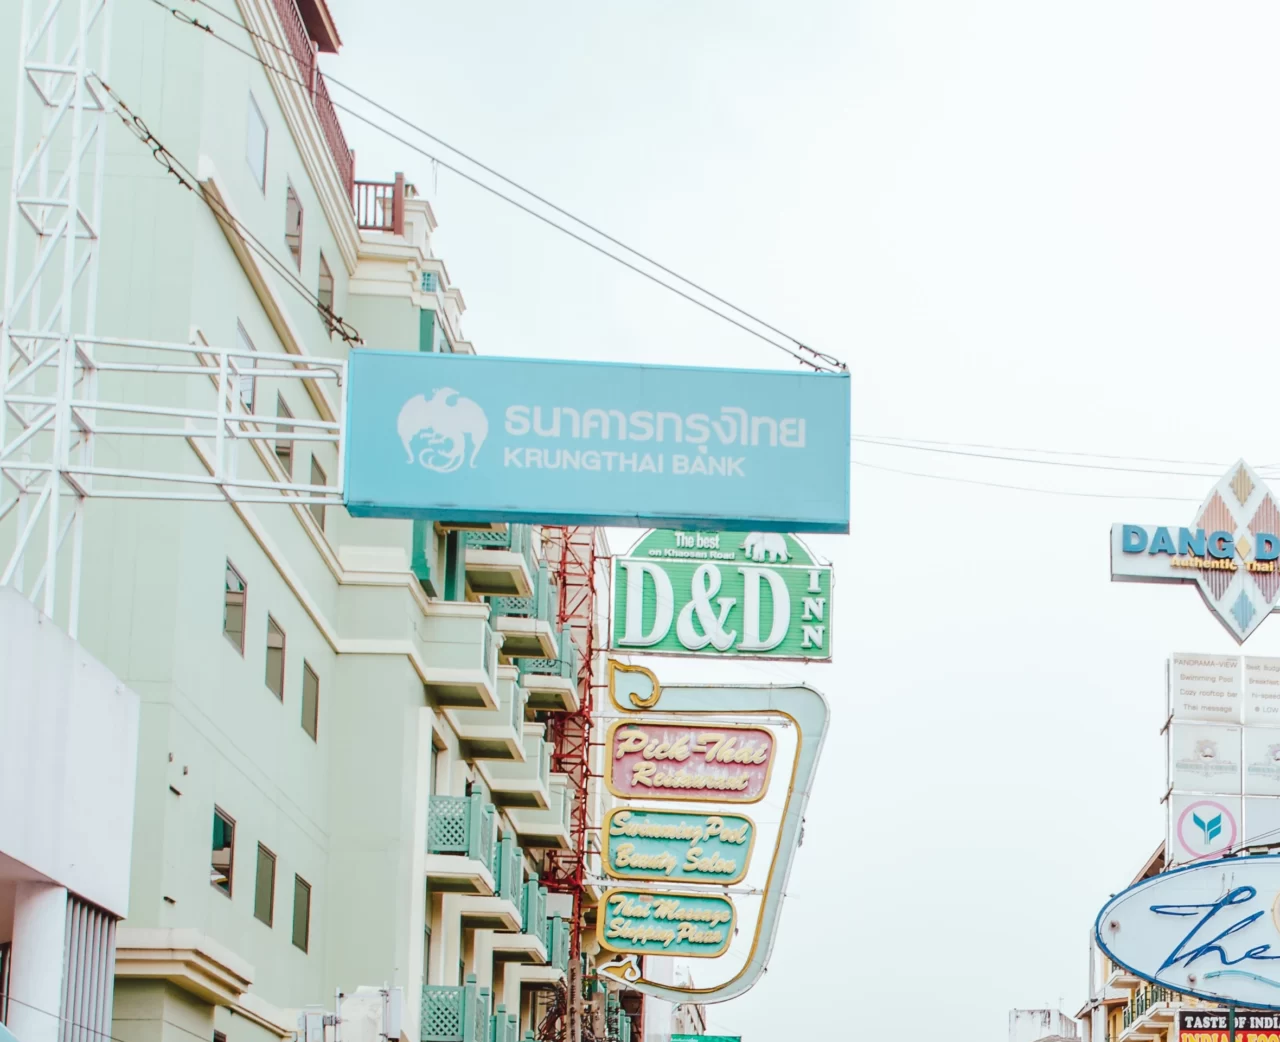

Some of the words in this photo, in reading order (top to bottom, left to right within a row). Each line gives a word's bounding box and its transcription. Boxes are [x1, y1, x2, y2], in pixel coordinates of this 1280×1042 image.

[504, 405, 807, 456] ธนาคารกรุงไทย
[503, 447, 664, 475] KRUNGTHAI
[672, 450, 746, 478] BANK
[648, 548, 662, 557] on
[664, 548, 708, 560] Khaosan
[709, 551, 735, 560] Road
[675, 532, 694, 549] The
[696, 532, 720, 550] best
[1121, 523, 1235, 560] DANG
[1170, 555, 1238, 571] Authentic
[1246, 559, 1275, 573] Thai
[617, 560, 792, 652] D&D
[801, 569, 827, 650] INN
[609, 811, 704, 847] Swimming
[703, 816, 750, 845] Pool
[615, 842, 678, 876] Beauty
[682, 847, 737, 875] Salon
[609, 894, 652, 918] Thai
[651, 898, 732, 928] Massage
[606, 917, 676, 948] Shopping
[1184, 1015, 1228, 1029] TASTE
